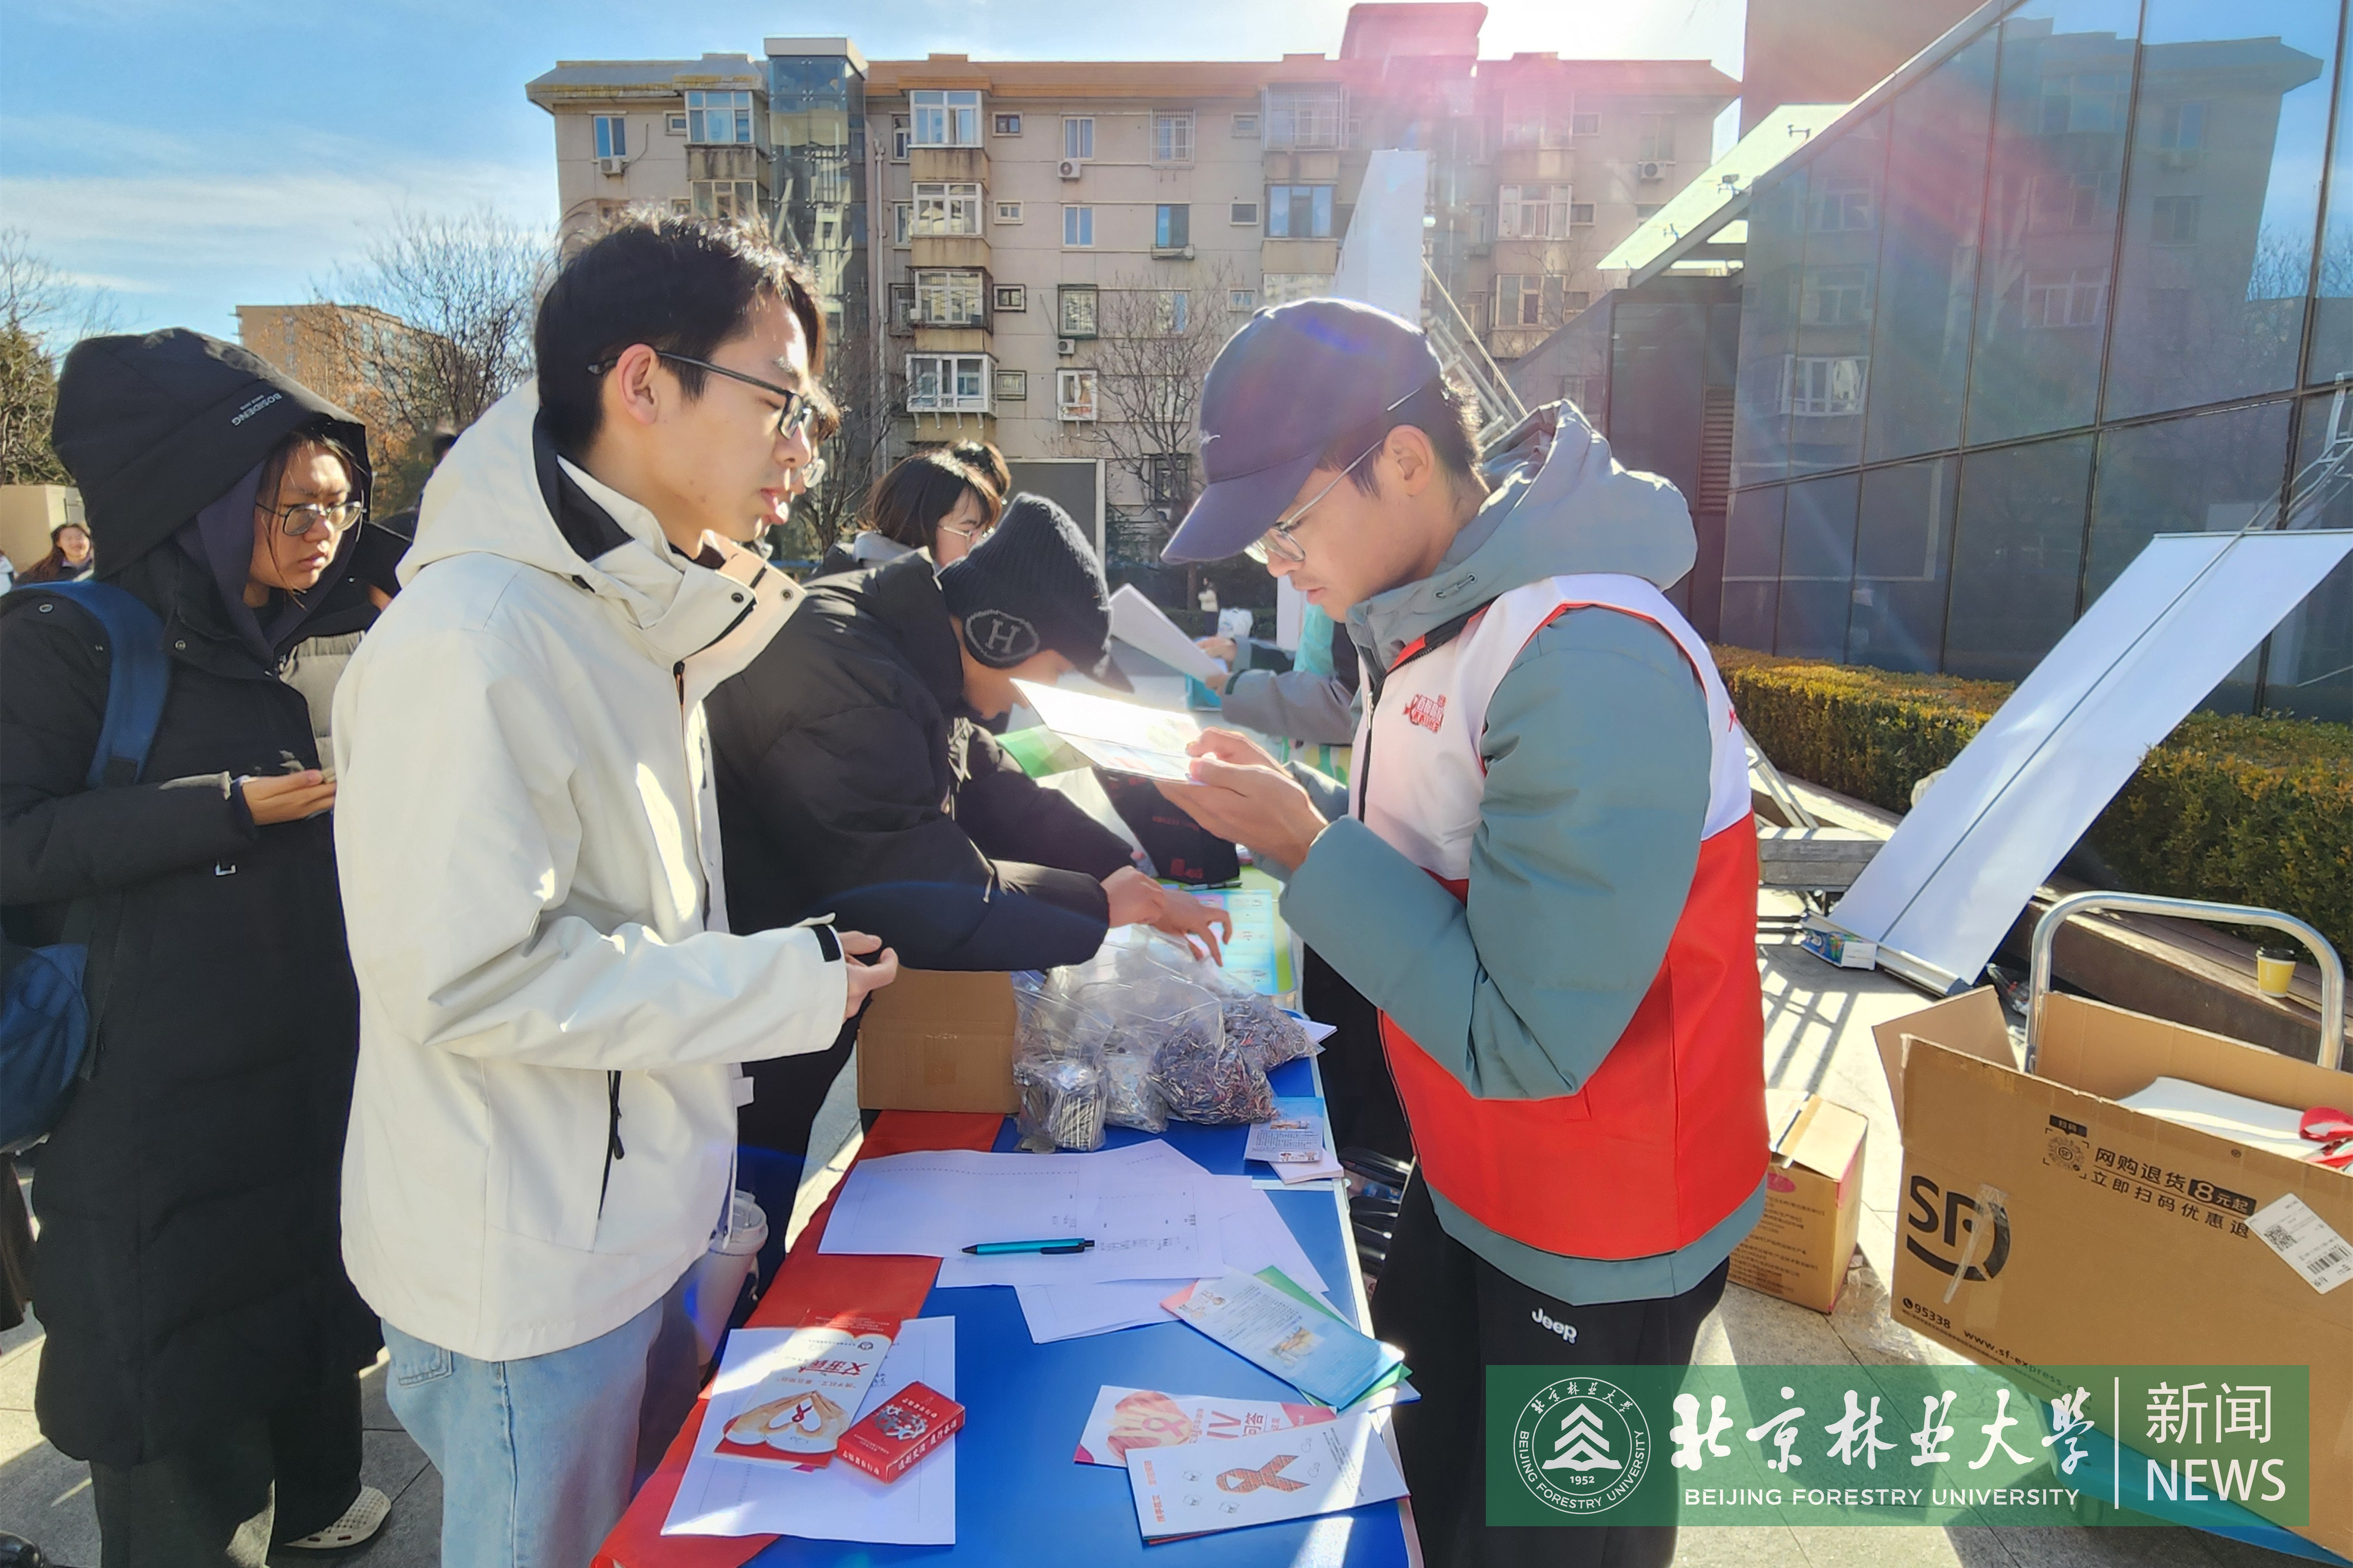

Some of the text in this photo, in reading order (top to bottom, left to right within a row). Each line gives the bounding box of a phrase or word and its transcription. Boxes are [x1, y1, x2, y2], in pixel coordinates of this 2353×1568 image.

[985, 619, 1021, 653] H
[2091, 1171, 2249, 1239] 立即扫码优惠退
[1532, 1308, 1577, 1341] Jeep
[1914, 1303, 1951, 1329] 95338
[1964, 1330, 2092, 1402] www.sf-express.c
